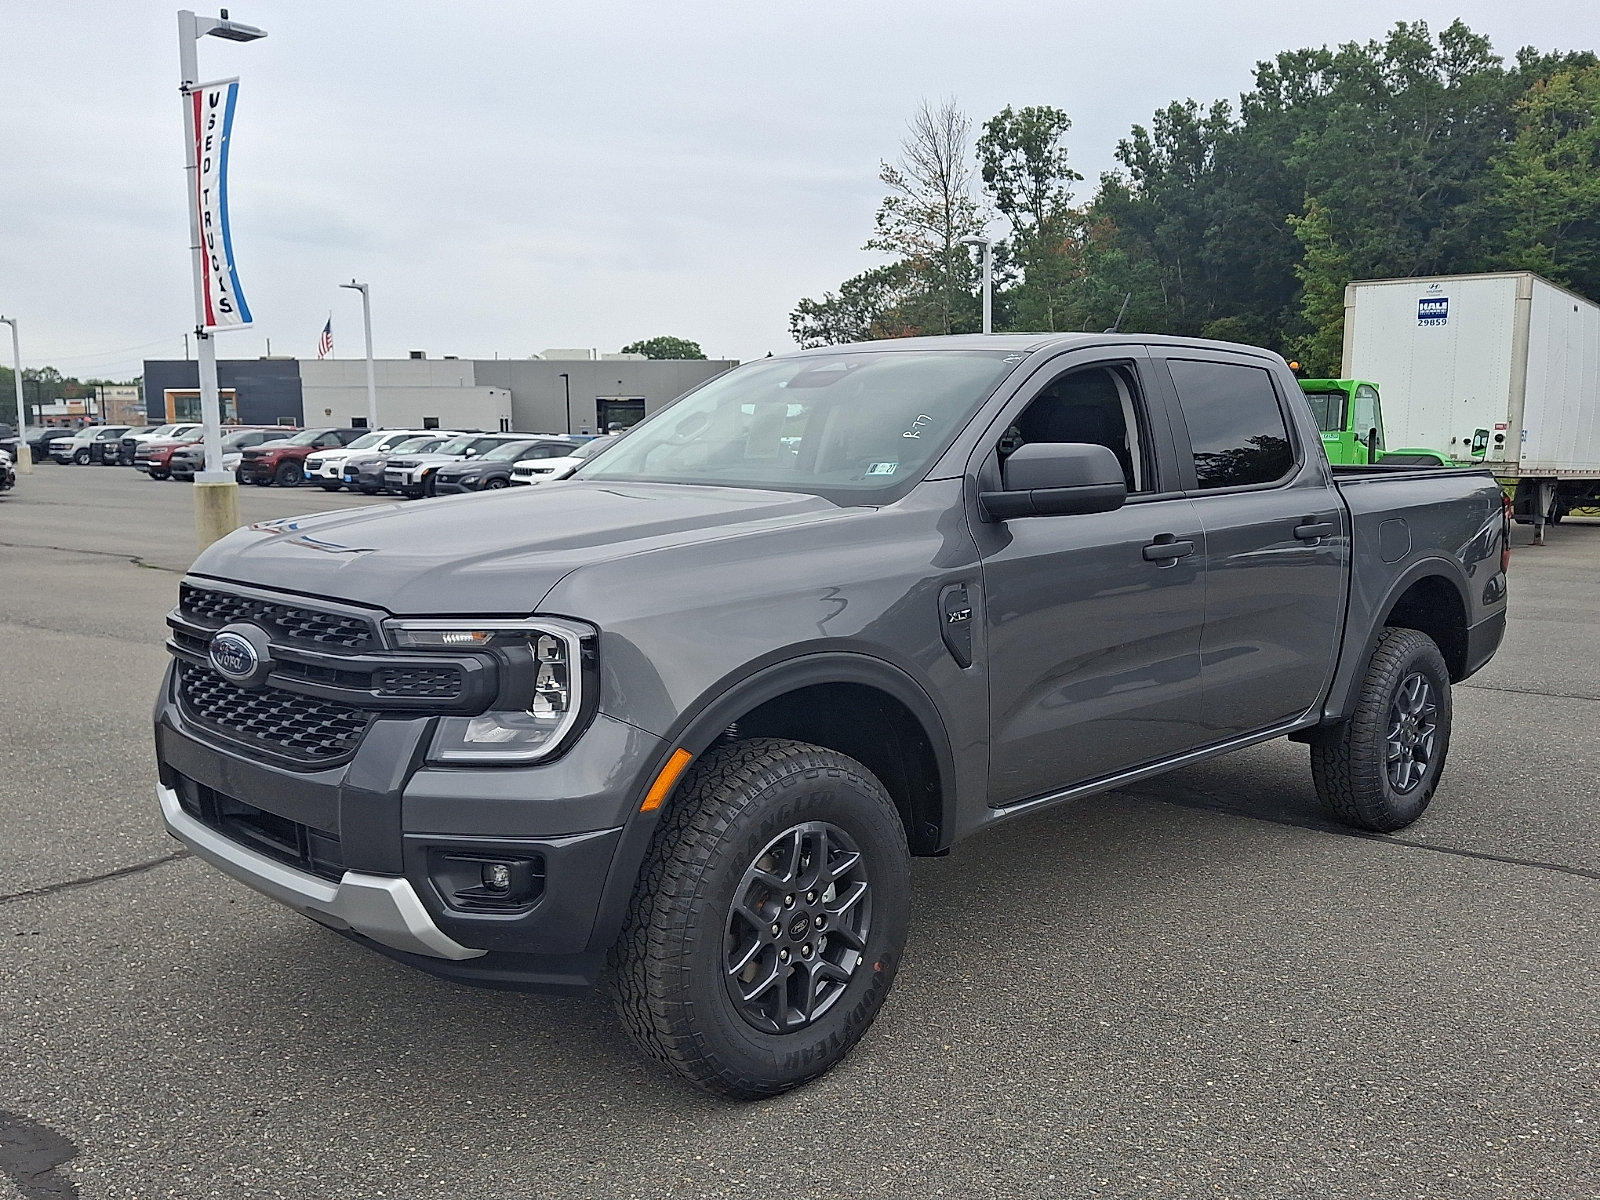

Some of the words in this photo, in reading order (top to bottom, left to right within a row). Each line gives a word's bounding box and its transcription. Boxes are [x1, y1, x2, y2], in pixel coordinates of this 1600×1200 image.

[204, 91, 220, 174] USED
[1417, 319, 1447, 327] 29859
[948, 609, 971, 622] XLT
[216, 641, 245, 670] Ford
